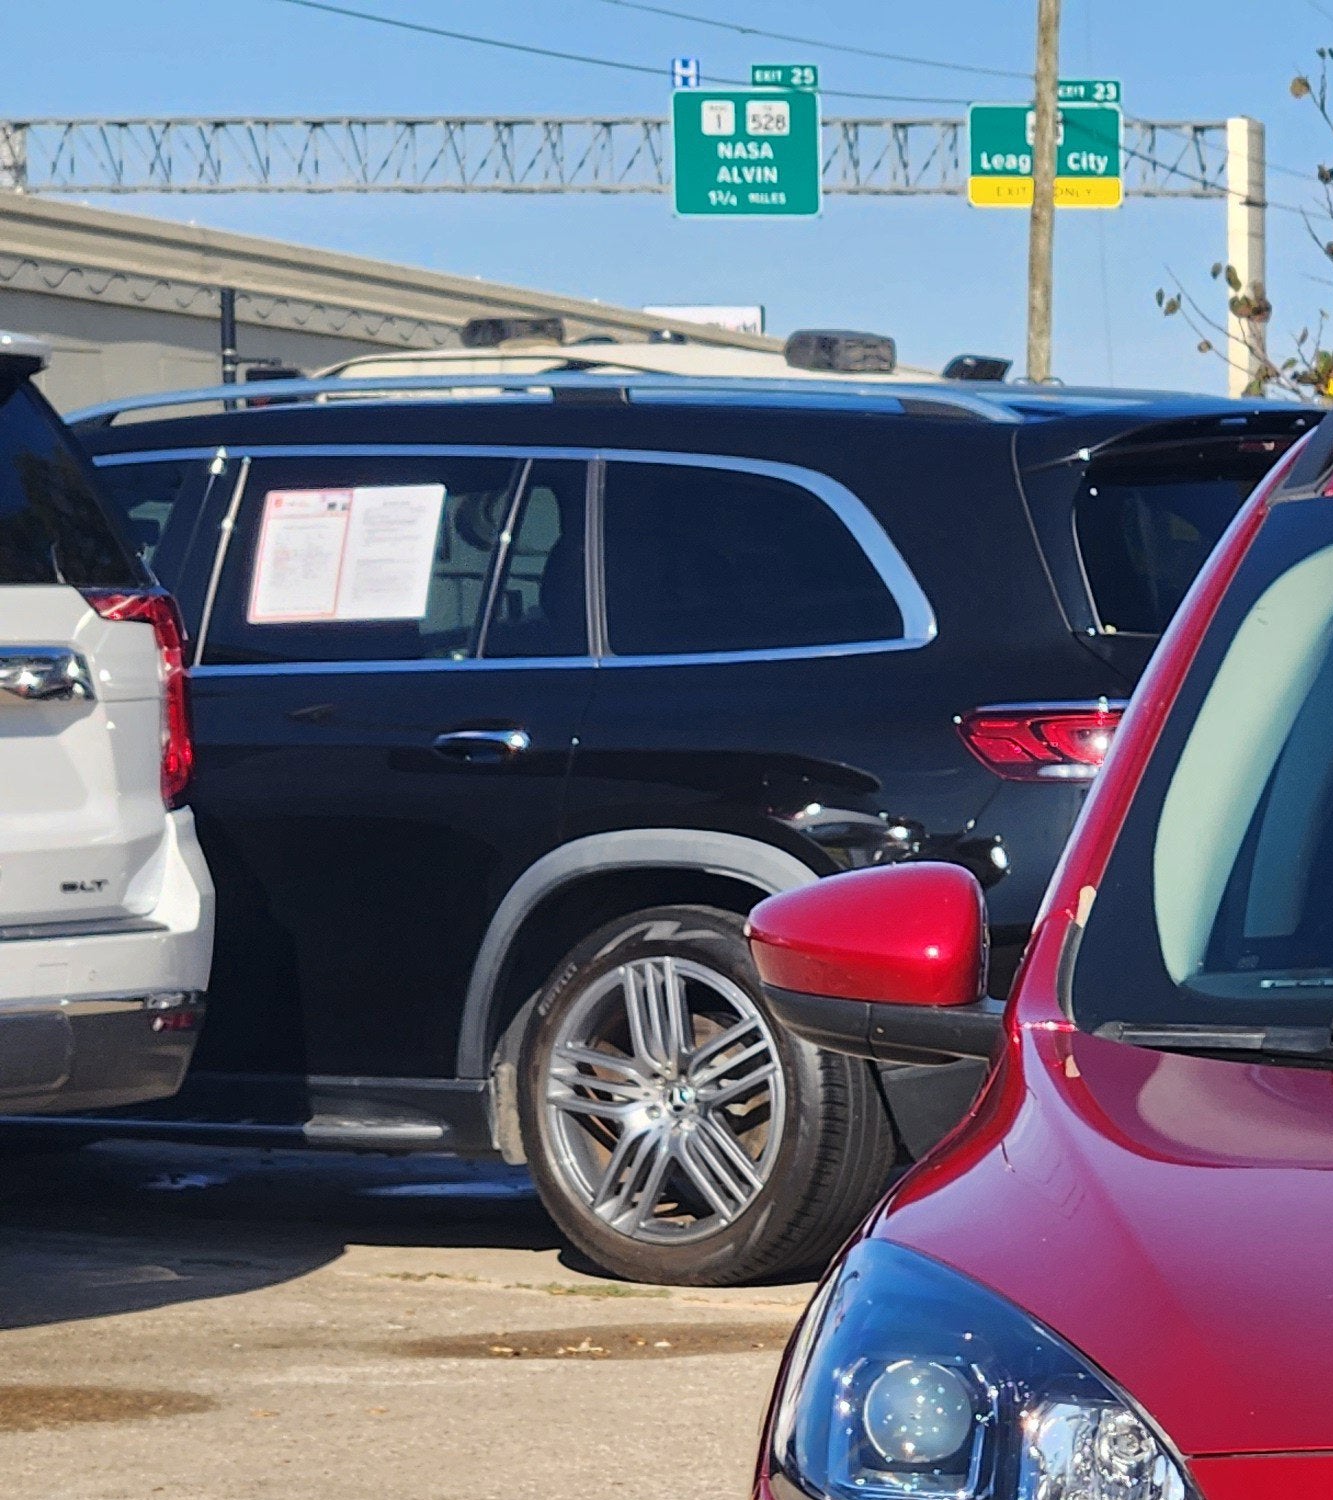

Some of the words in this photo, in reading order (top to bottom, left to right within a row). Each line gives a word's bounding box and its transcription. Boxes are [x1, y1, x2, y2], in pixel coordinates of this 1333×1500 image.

[674, 59, 697, 87] H
[754, 69, 782, 83] EXIT
[790, 67, 815, 85] 25
[1092, 82, 1117, 100] 23
[751, 113, 786, 131] 528
[716, 141, 774, 160] NASA
[980, 151, 1032, 174] Leag
[1067, 151, 1108, 174] City
[716, 165, 778, 185] ALVIN
[748, 192, 787, 205] MILES
[995, 186, 1027, 196] EXIT
